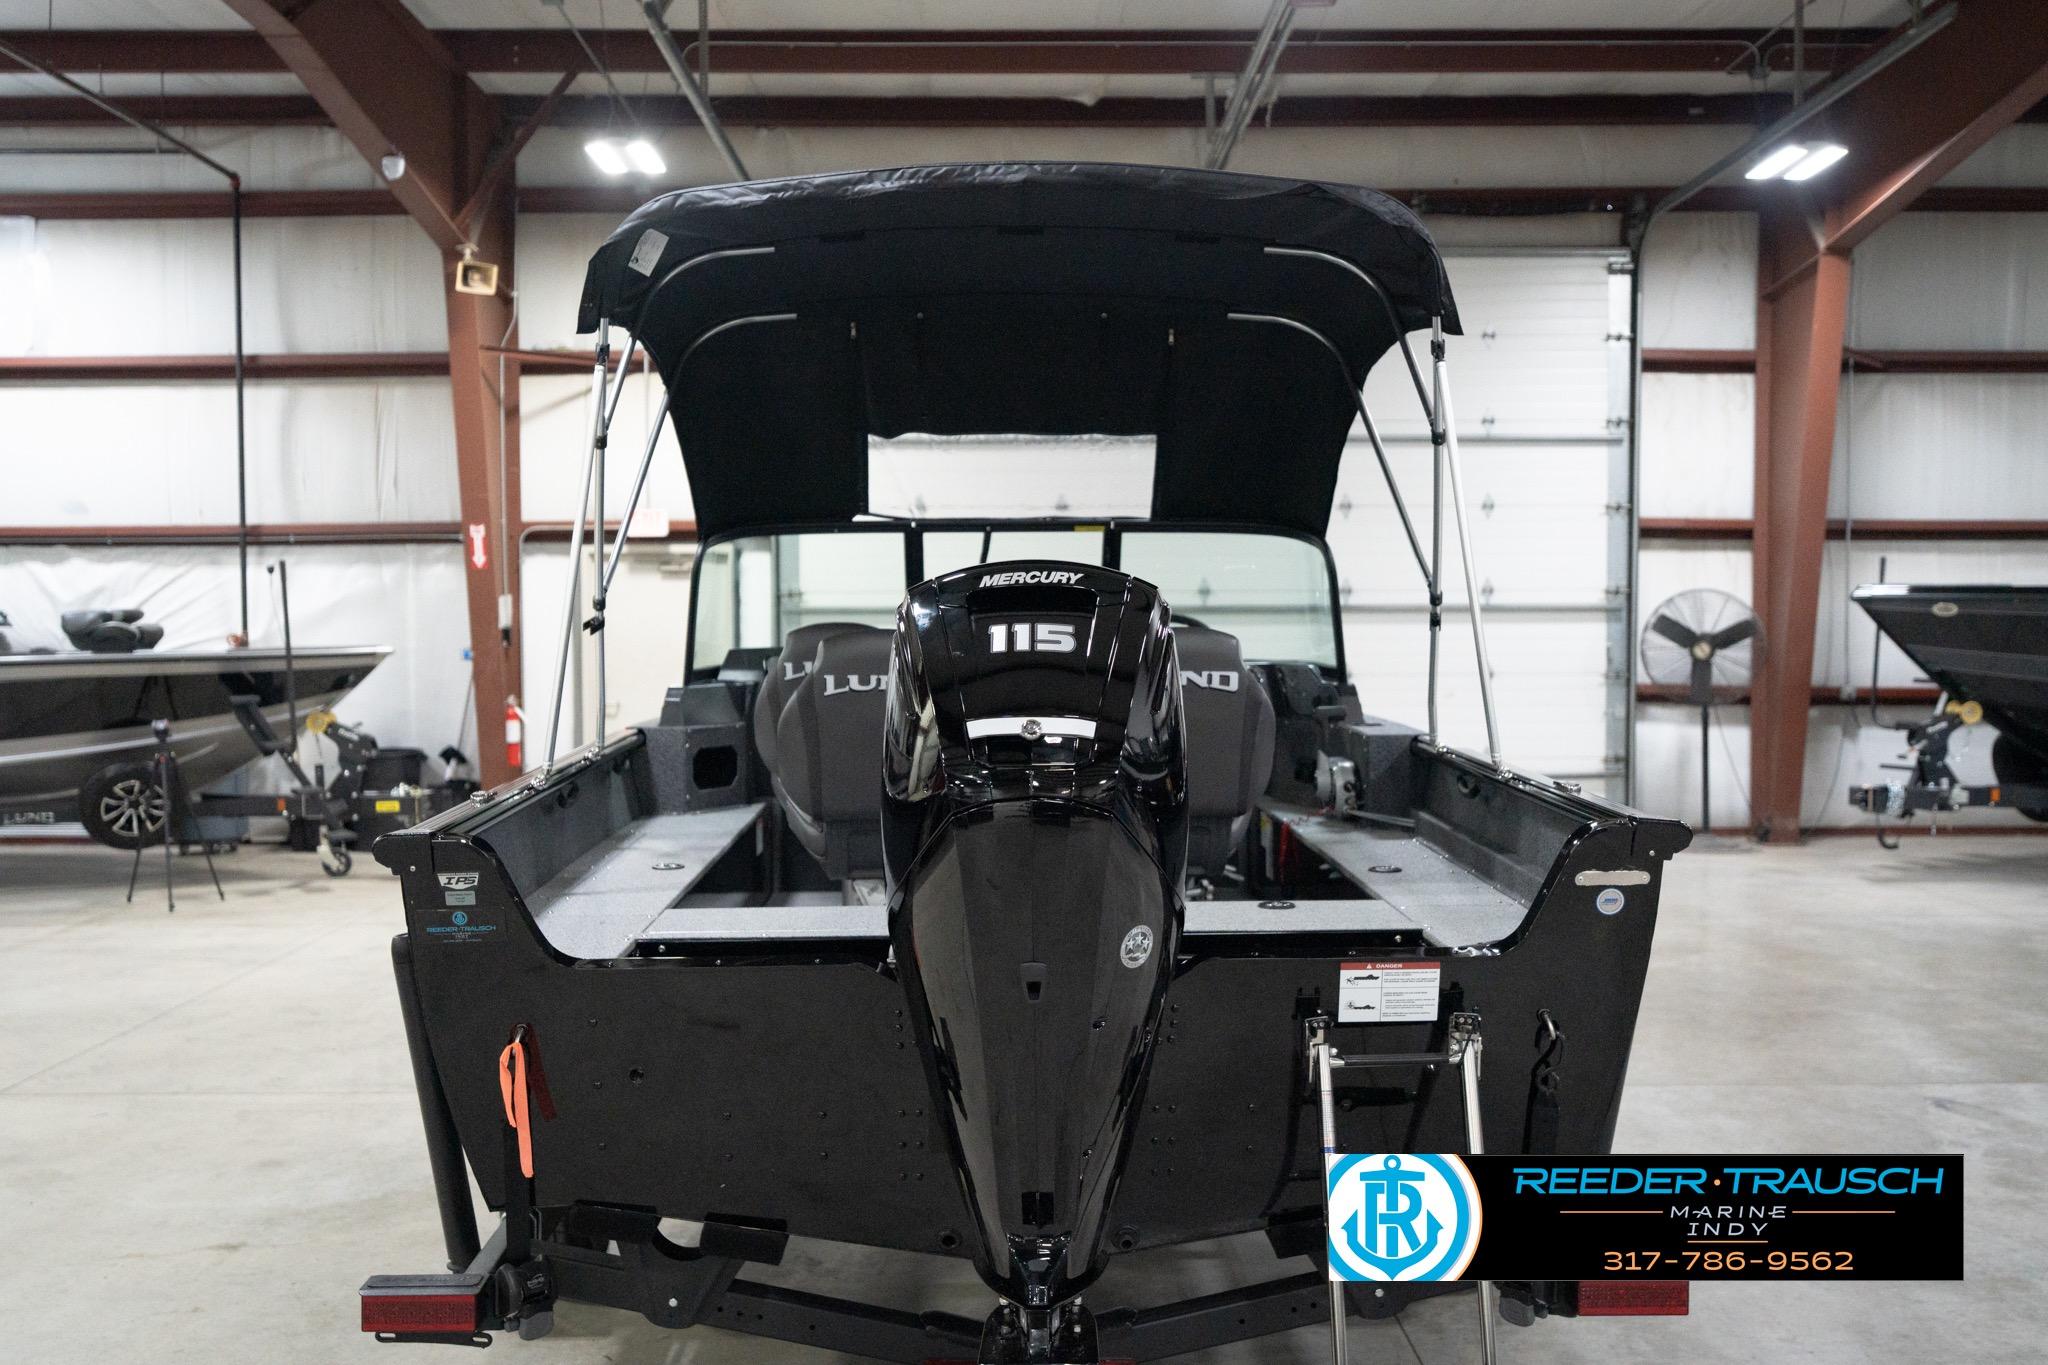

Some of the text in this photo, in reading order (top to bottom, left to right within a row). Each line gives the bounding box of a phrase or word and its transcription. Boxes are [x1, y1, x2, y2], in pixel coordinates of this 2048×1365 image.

[979, 571, 1084, 588] MERCURY
[988, 622, 1077, 654] 115
[823, 674, 888, 696] LU
[1179, 671, 1239, 693] ND
[443, 876, 477, 886] IPS
